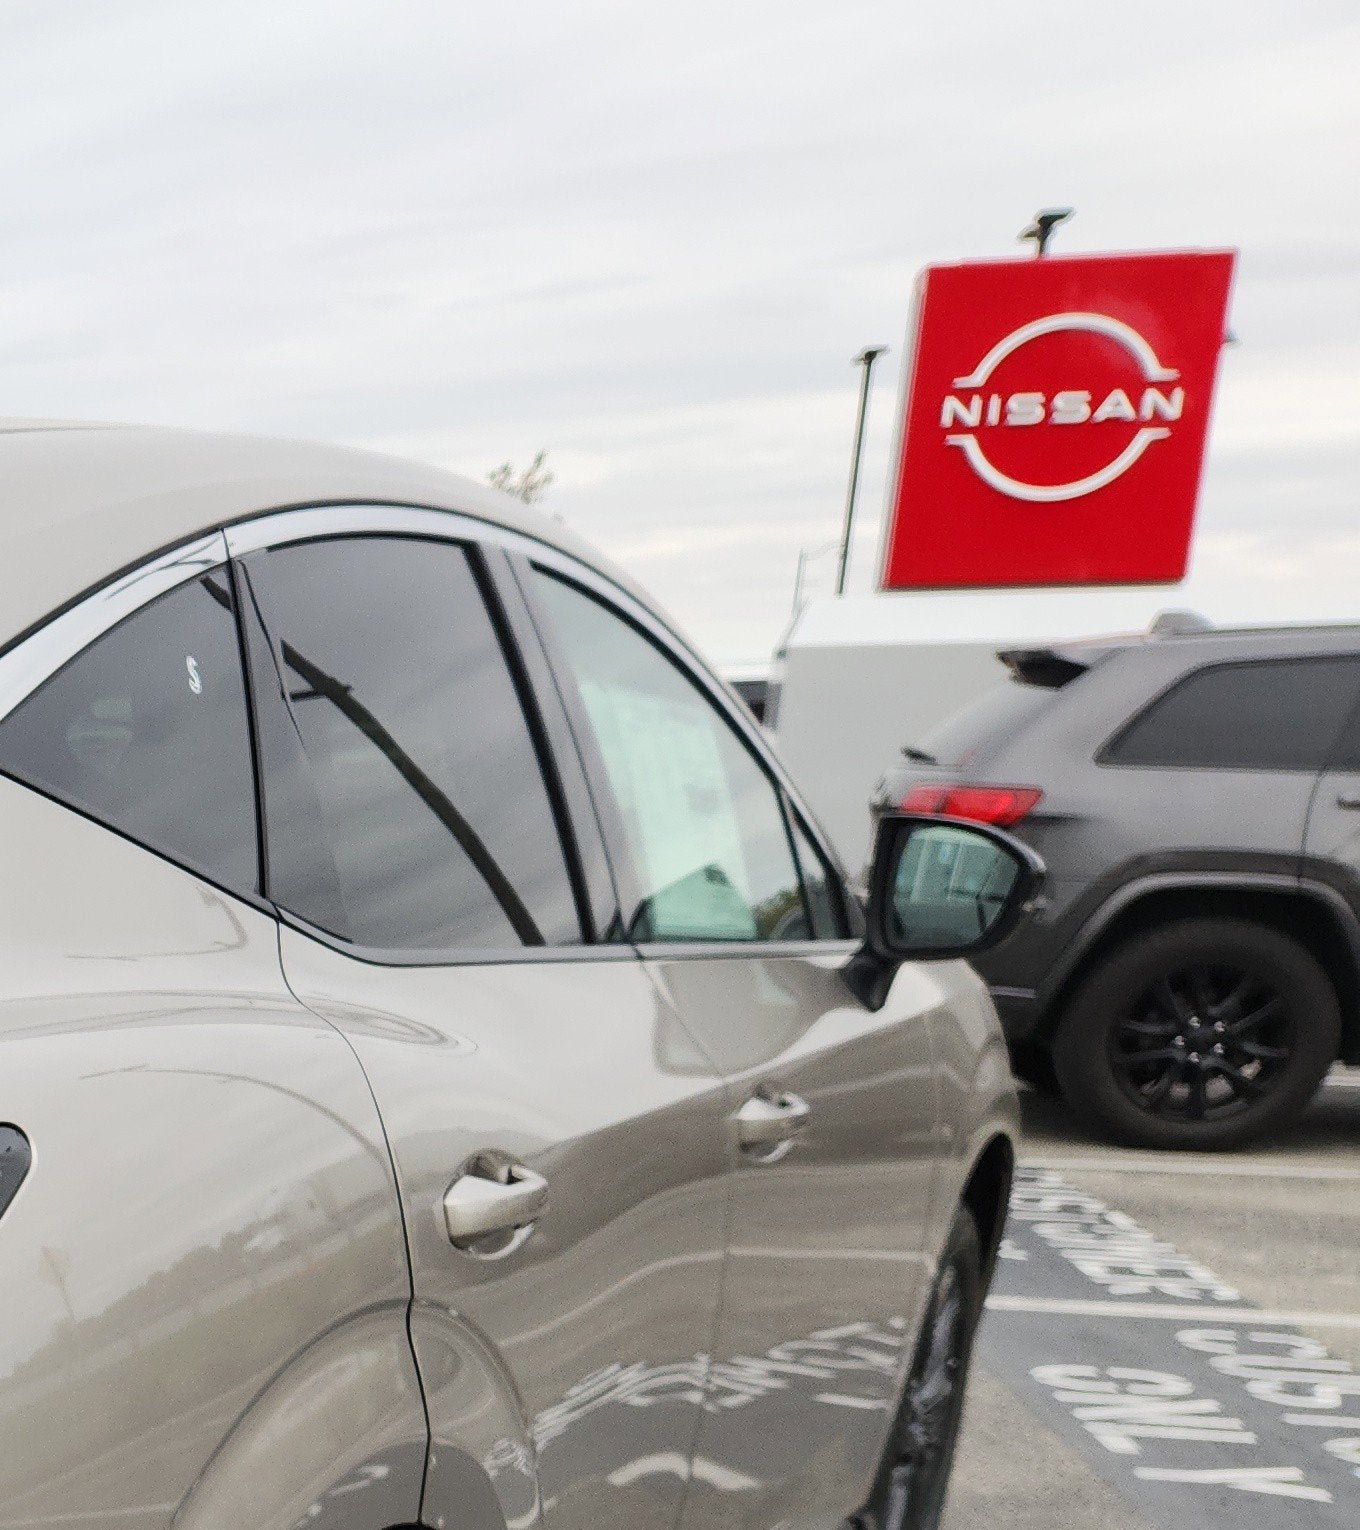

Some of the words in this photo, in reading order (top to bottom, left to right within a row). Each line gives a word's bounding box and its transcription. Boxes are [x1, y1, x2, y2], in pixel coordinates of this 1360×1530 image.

[940, 387, 1185, 429] NISSAN
[1030, 1364, 1334, 1503] ONLY
[1177, 1329, 1360, 1466] CUST
